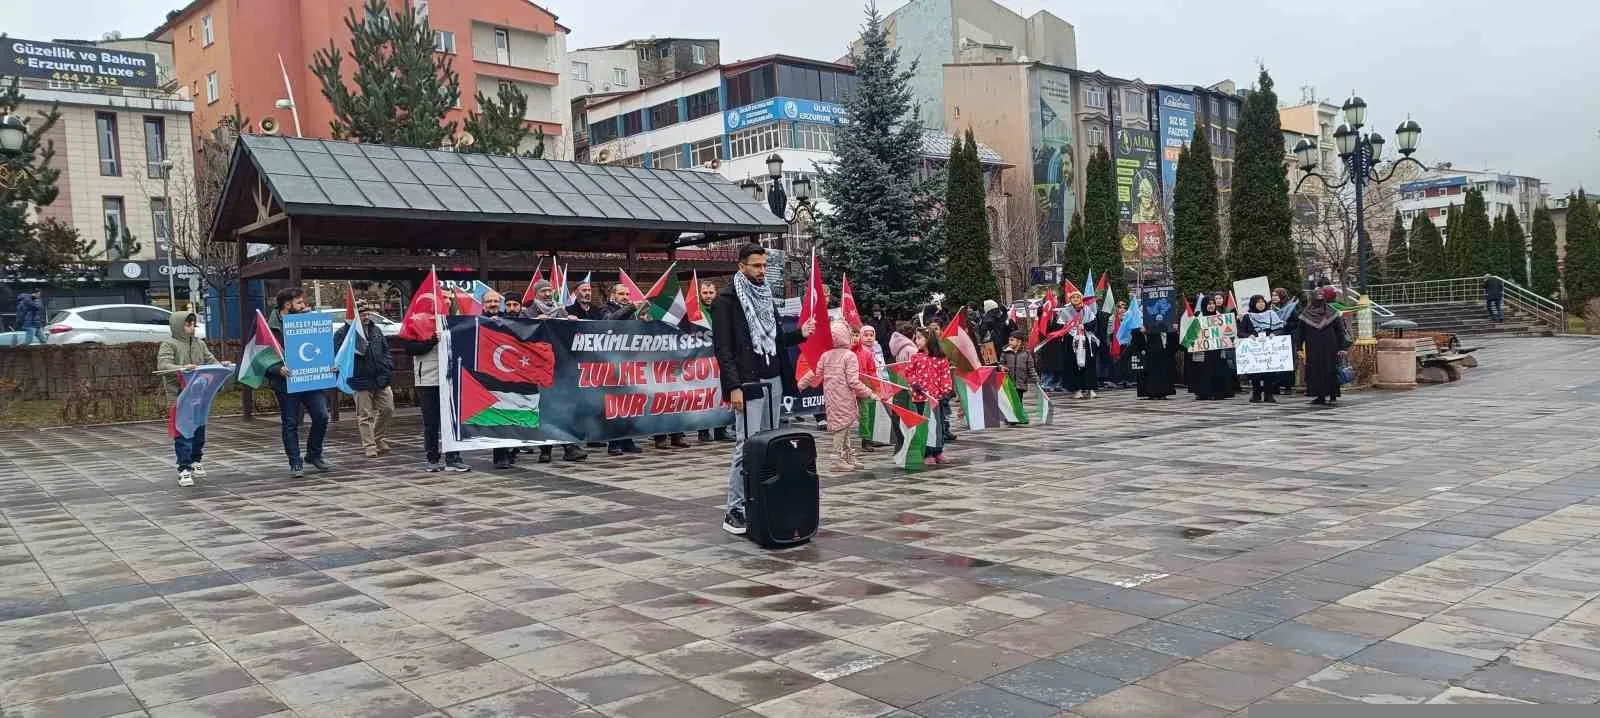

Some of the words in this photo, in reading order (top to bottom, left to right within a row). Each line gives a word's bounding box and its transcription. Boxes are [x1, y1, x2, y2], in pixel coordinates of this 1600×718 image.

[12, 42, 76, 60] Güzellik
[79, 51, 97, 62] ve
[101, 52, 146, 67] Bakım
[28, 57, 94, 73] Erzurum
[99, 65, 134, 78] Luxe
[52, 72, 79, 83] 444
[95, 75, 119, 86] 312
[571, 330, 677, 352] HEKİMLERDEN
[577, 359, 648, 389] ZULME
[653, 359, 677, 386] VE
[682, 355, 720, 384] SOY
[603, 393, 648, 420] DUR
[651, 387, 717, 416] DEMEK
